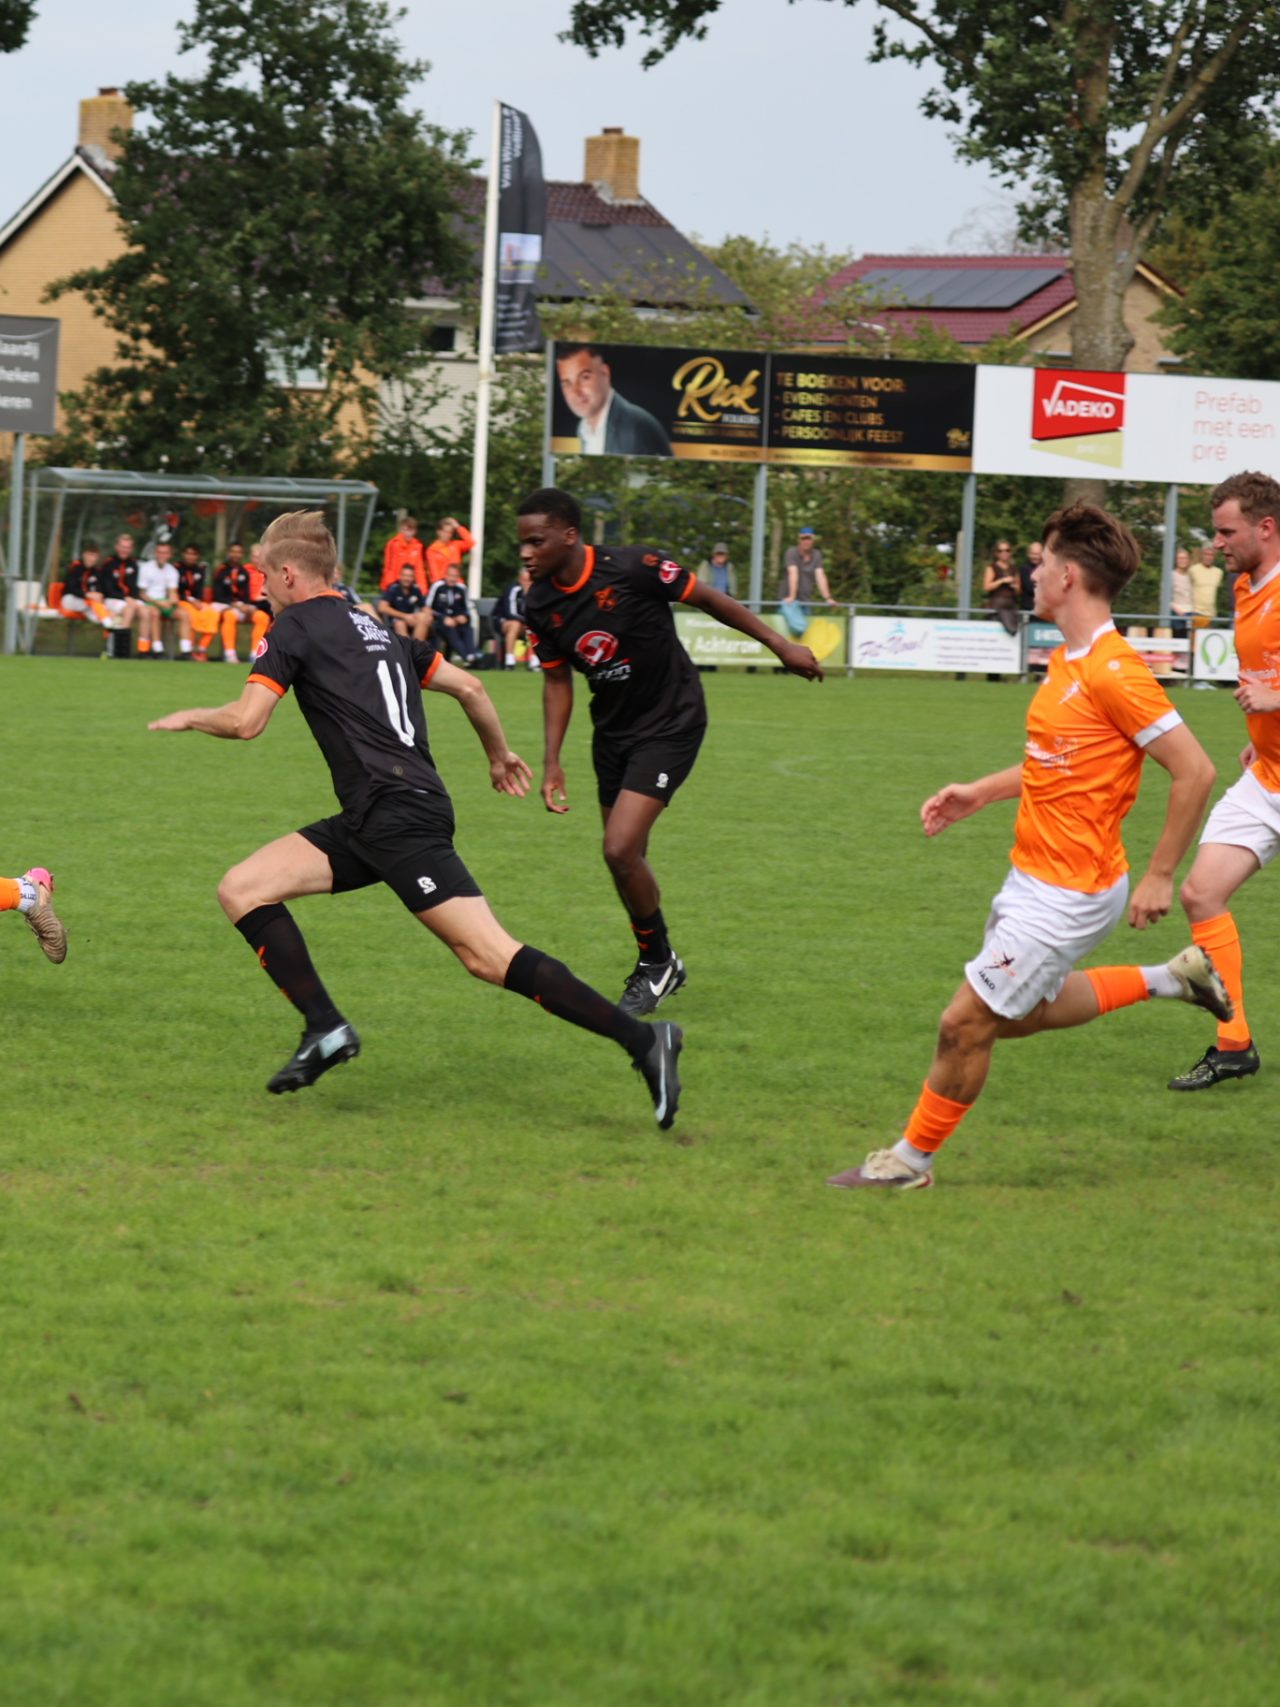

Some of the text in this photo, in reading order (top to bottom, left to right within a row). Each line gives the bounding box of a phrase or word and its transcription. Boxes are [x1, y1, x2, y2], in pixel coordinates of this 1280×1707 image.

[672, 356, 761, 421] Rick
[776, 372, 795, 387] TE
[796, 373, 858, 390] BOEKEN
[1041, 397, 1117, 419] VADEKO
[1195, 390, 1263, 414] Prefab
[845, 412, 885, 426] CLUBS
[1193, 419, 1276, 439] met een
[781, 425, 865, 442] PERSOONLIJK
